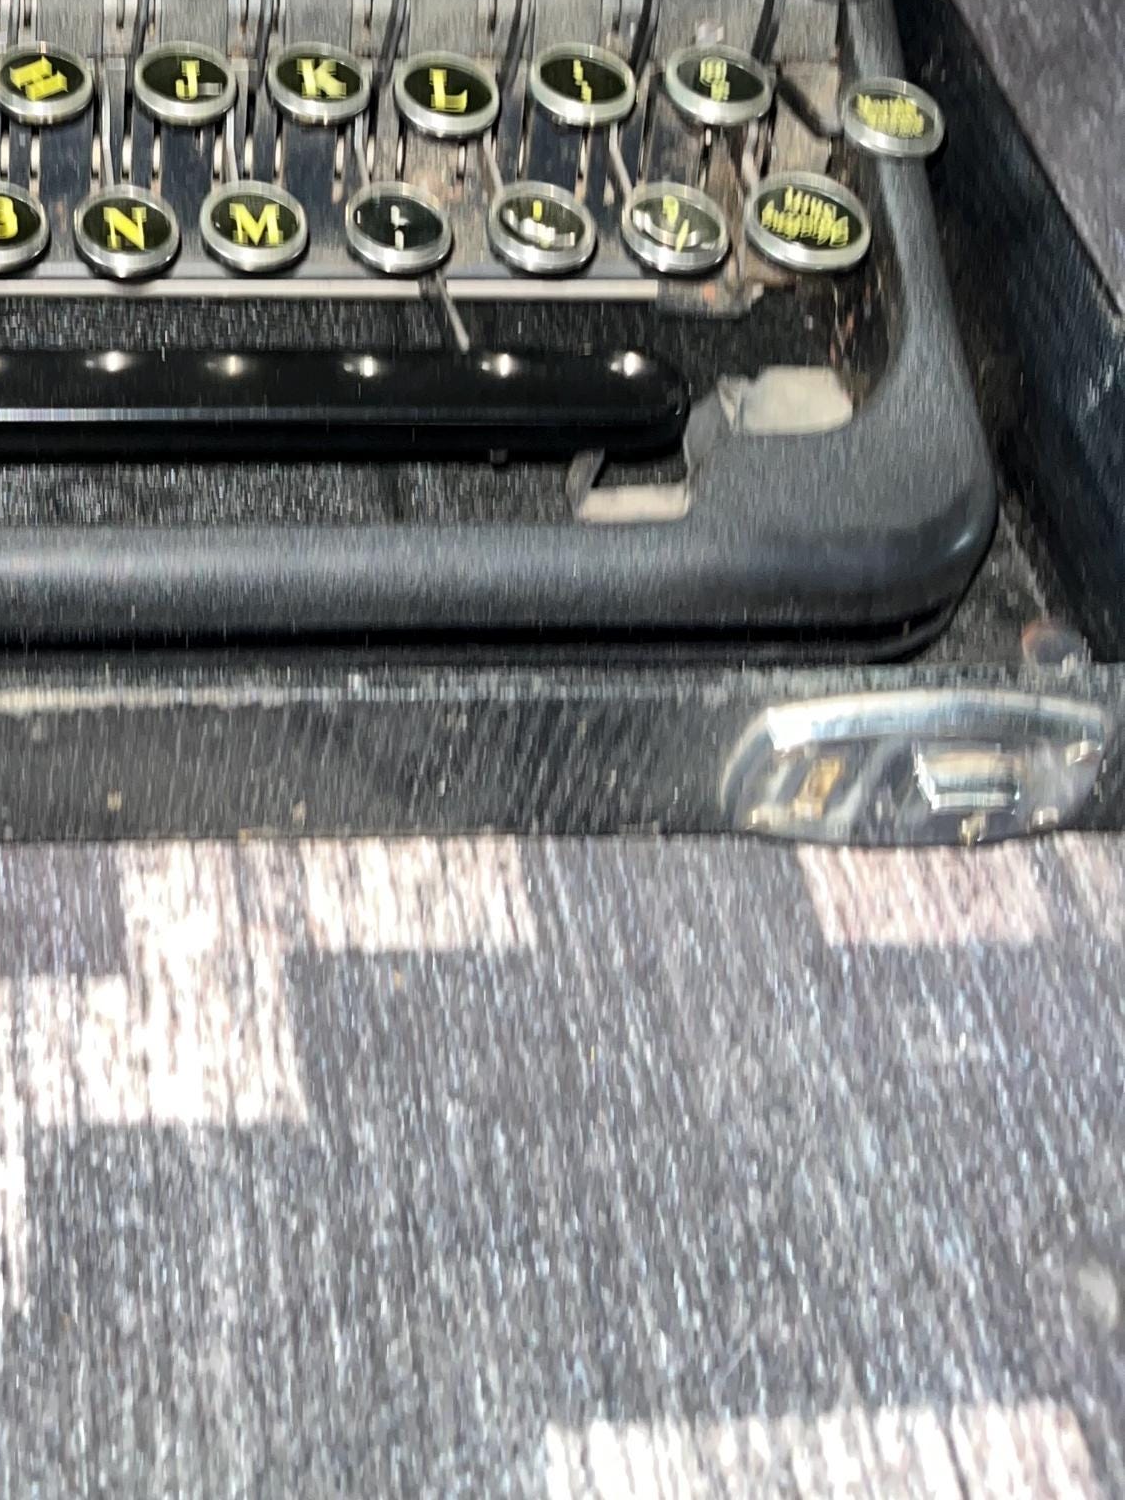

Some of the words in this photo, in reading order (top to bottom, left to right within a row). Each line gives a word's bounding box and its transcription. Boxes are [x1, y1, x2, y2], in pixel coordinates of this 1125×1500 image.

[175, 59, 200, 100] J
[297, 58, 347, 100] K
[429, 68, 468, 113] L
[102, 206, 147, 251] N
[229, 201, 284, 249] M
